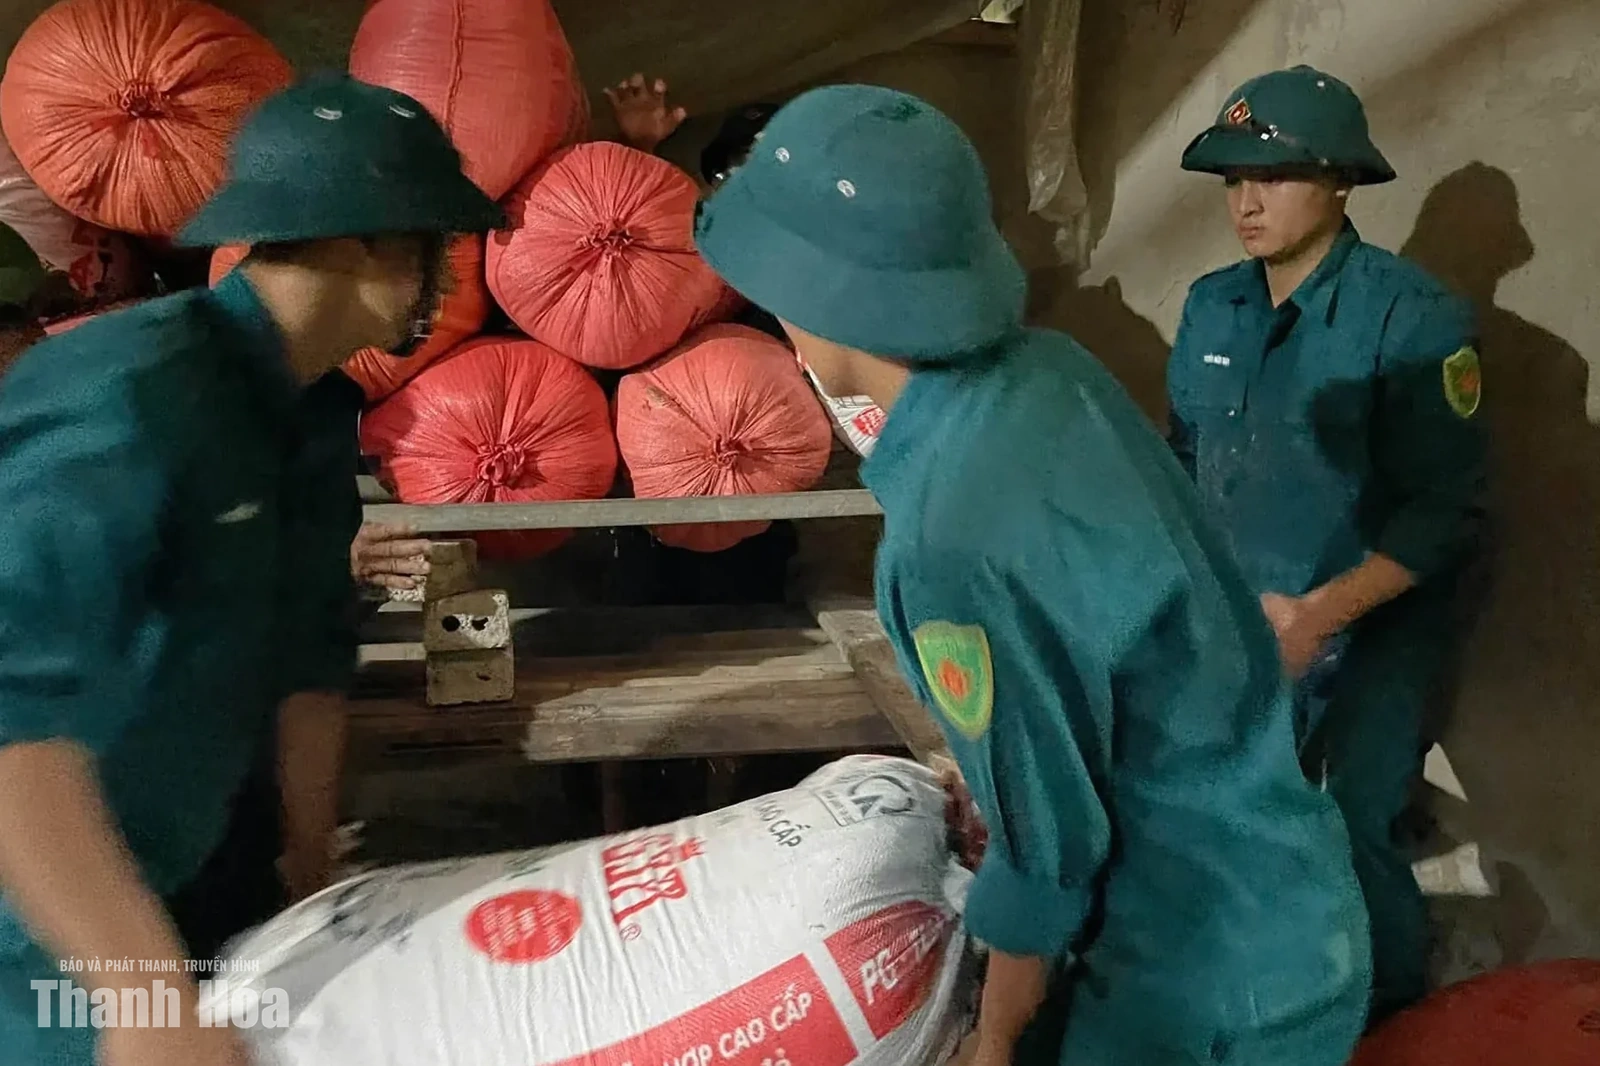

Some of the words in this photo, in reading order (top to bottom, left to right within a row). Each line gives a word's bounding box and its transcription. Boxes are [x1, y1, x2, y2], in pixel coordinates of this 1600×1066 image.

[769, 819, 811, 847] CẤP
[718, 1017, 765, 1059] CAO
[771, 982, 812, 1031] CẤP
